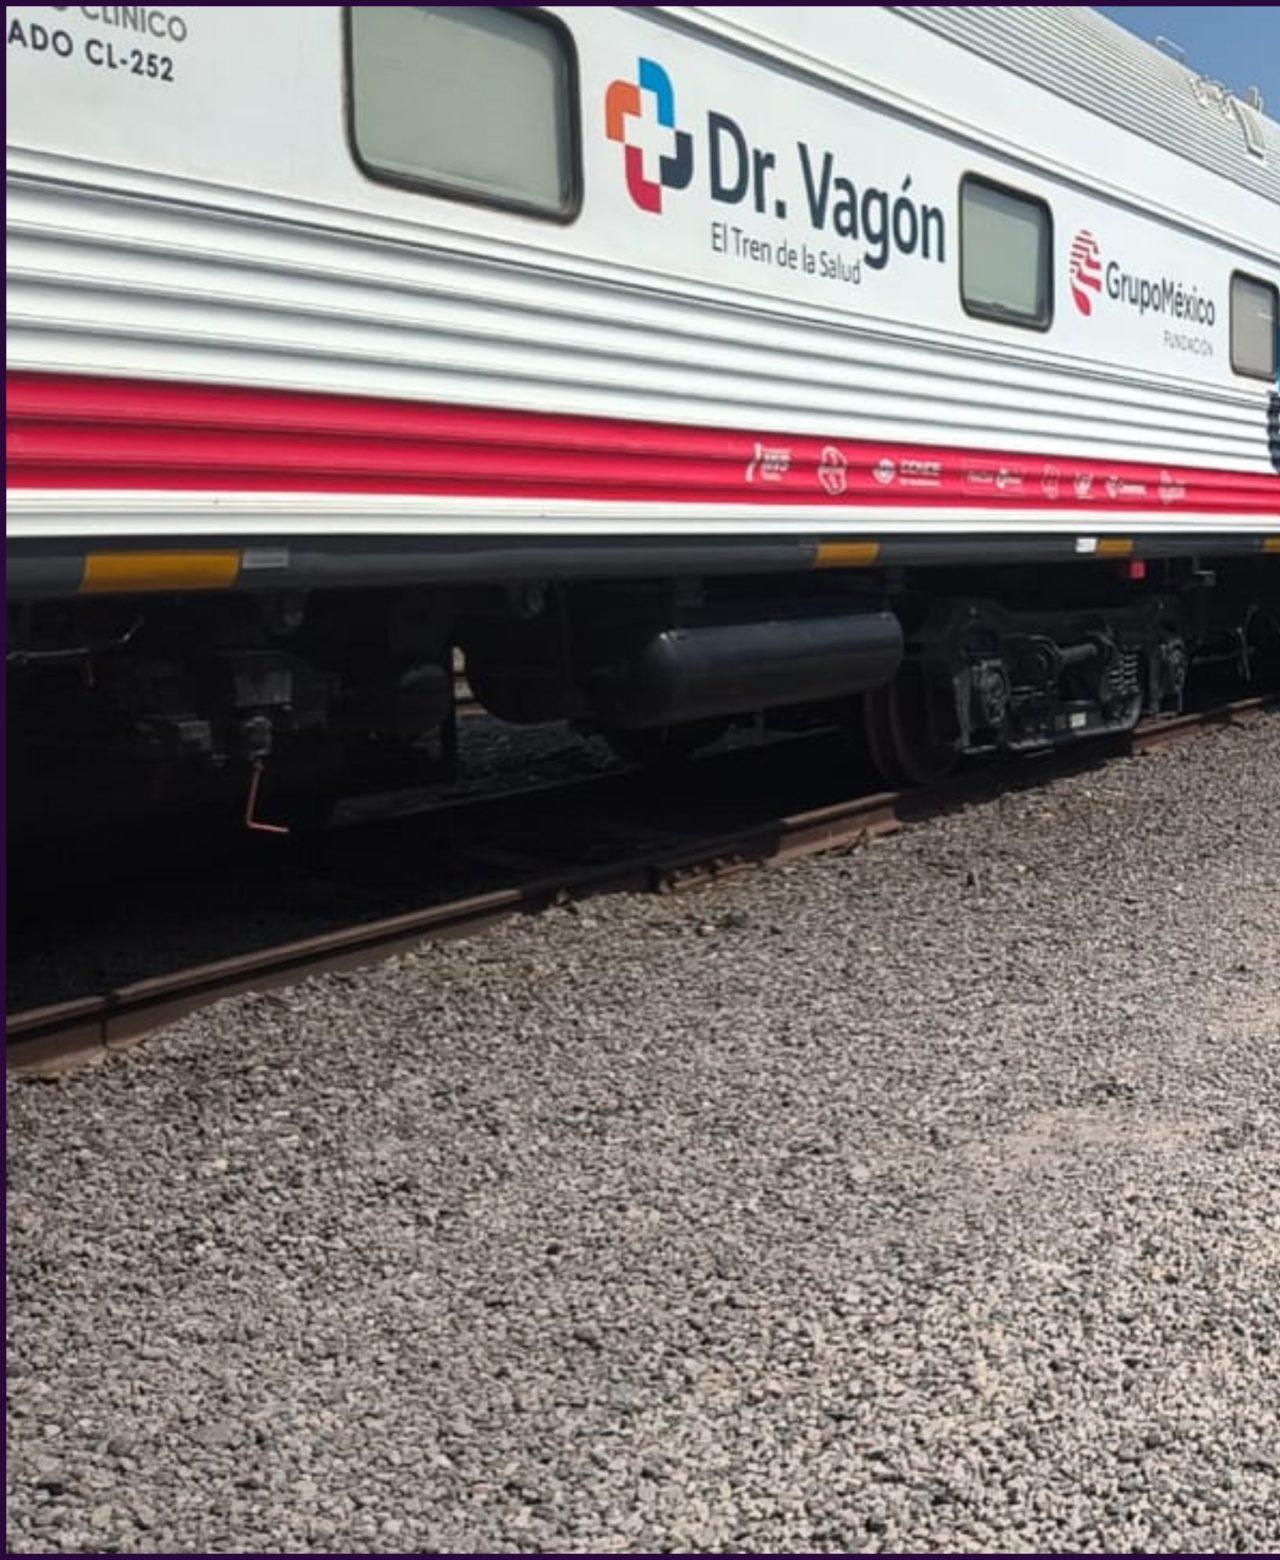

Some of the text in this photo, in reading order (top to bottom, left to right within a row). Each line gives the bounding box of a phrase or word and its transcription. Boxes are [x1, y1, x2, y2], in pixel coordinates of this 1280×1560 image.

[85, 38, 174, 82] CL-252
[707, 109, 946, 270] Dr. Vagón
[711, 222, 861, 284] El Tren de la Salud
[1105, 260, 1216, 327] GrupoMéxico
